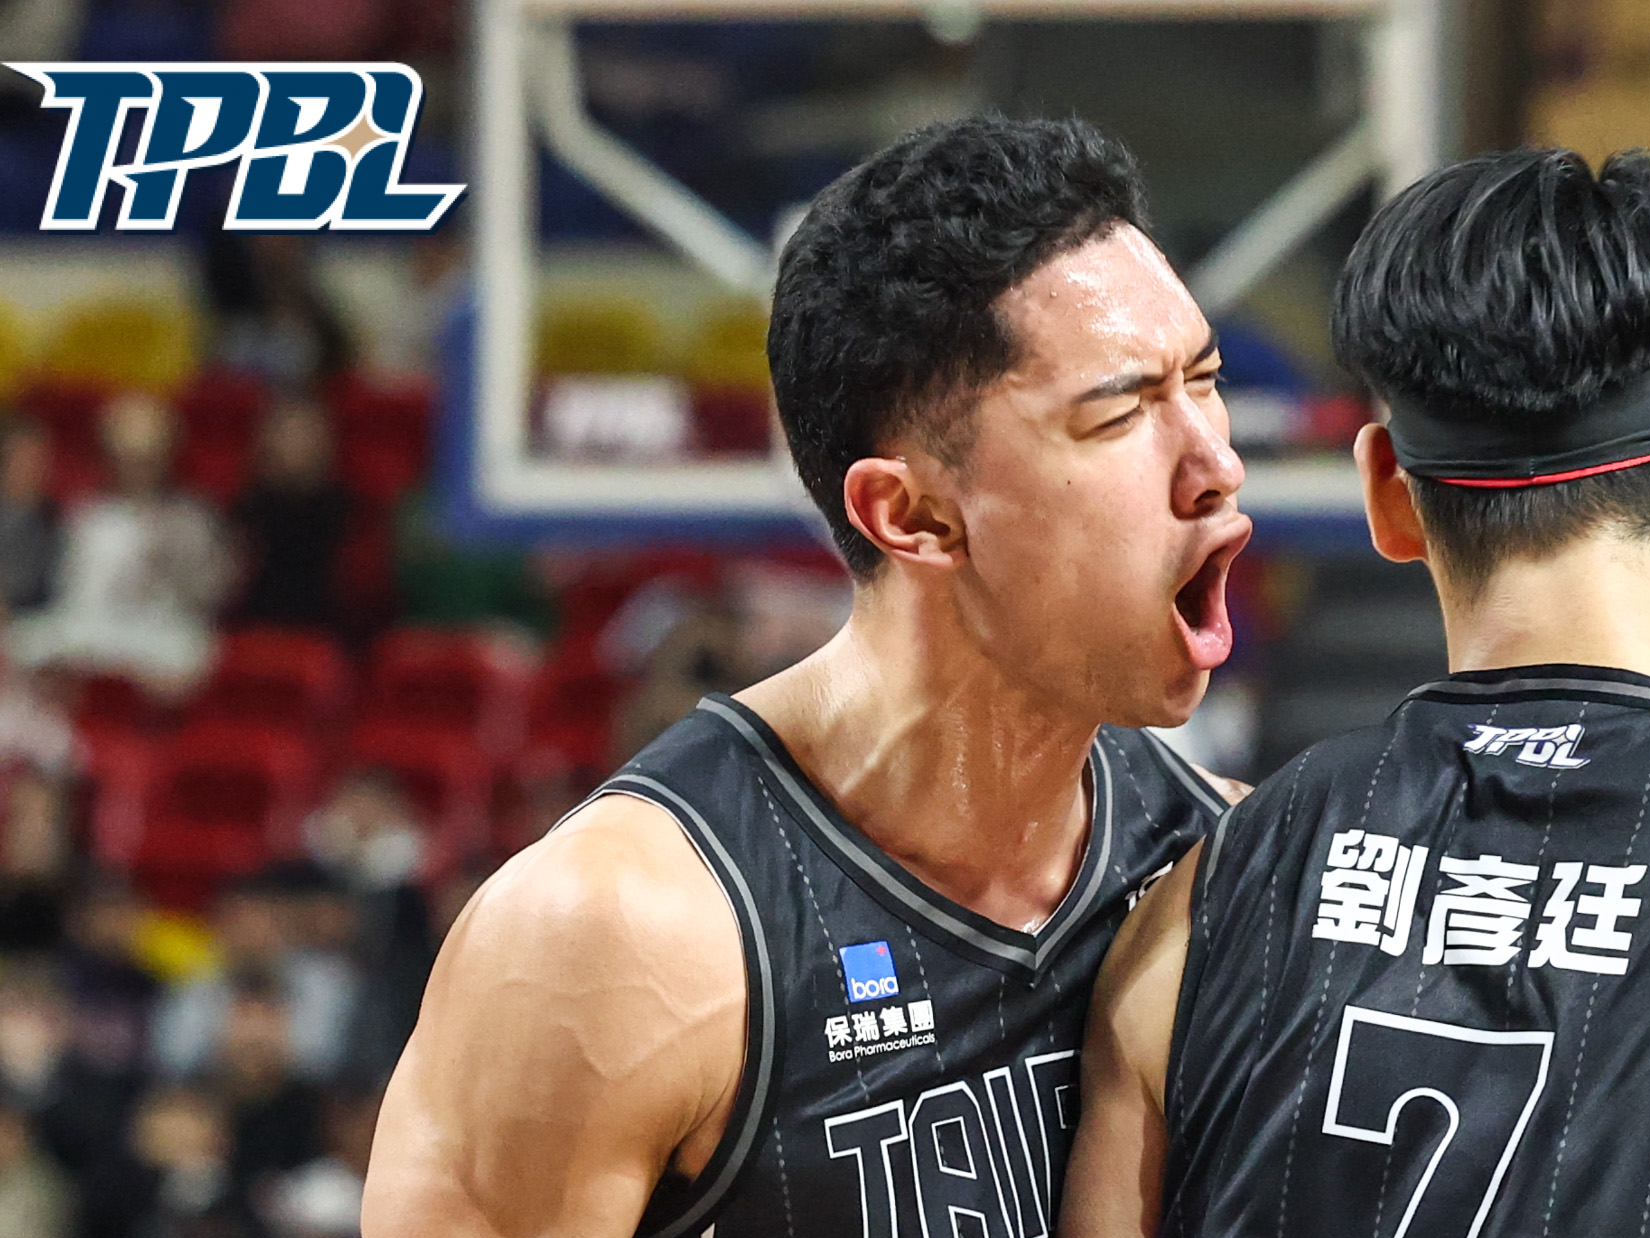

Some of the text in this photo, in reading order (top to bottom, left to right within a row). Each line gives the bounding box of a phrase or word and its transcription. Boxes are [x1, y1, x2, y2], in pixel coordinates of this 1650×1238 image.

[1463, 723, 1590, 769] TPBL
[1312, 829, 1647, 975] 劉彥廷
[851, 976, 899, 999] bora
[824, 1000, 935, 1048] 保瑞集團
[828, 1033, 936, 1063] Bora Pharmaceuticals
